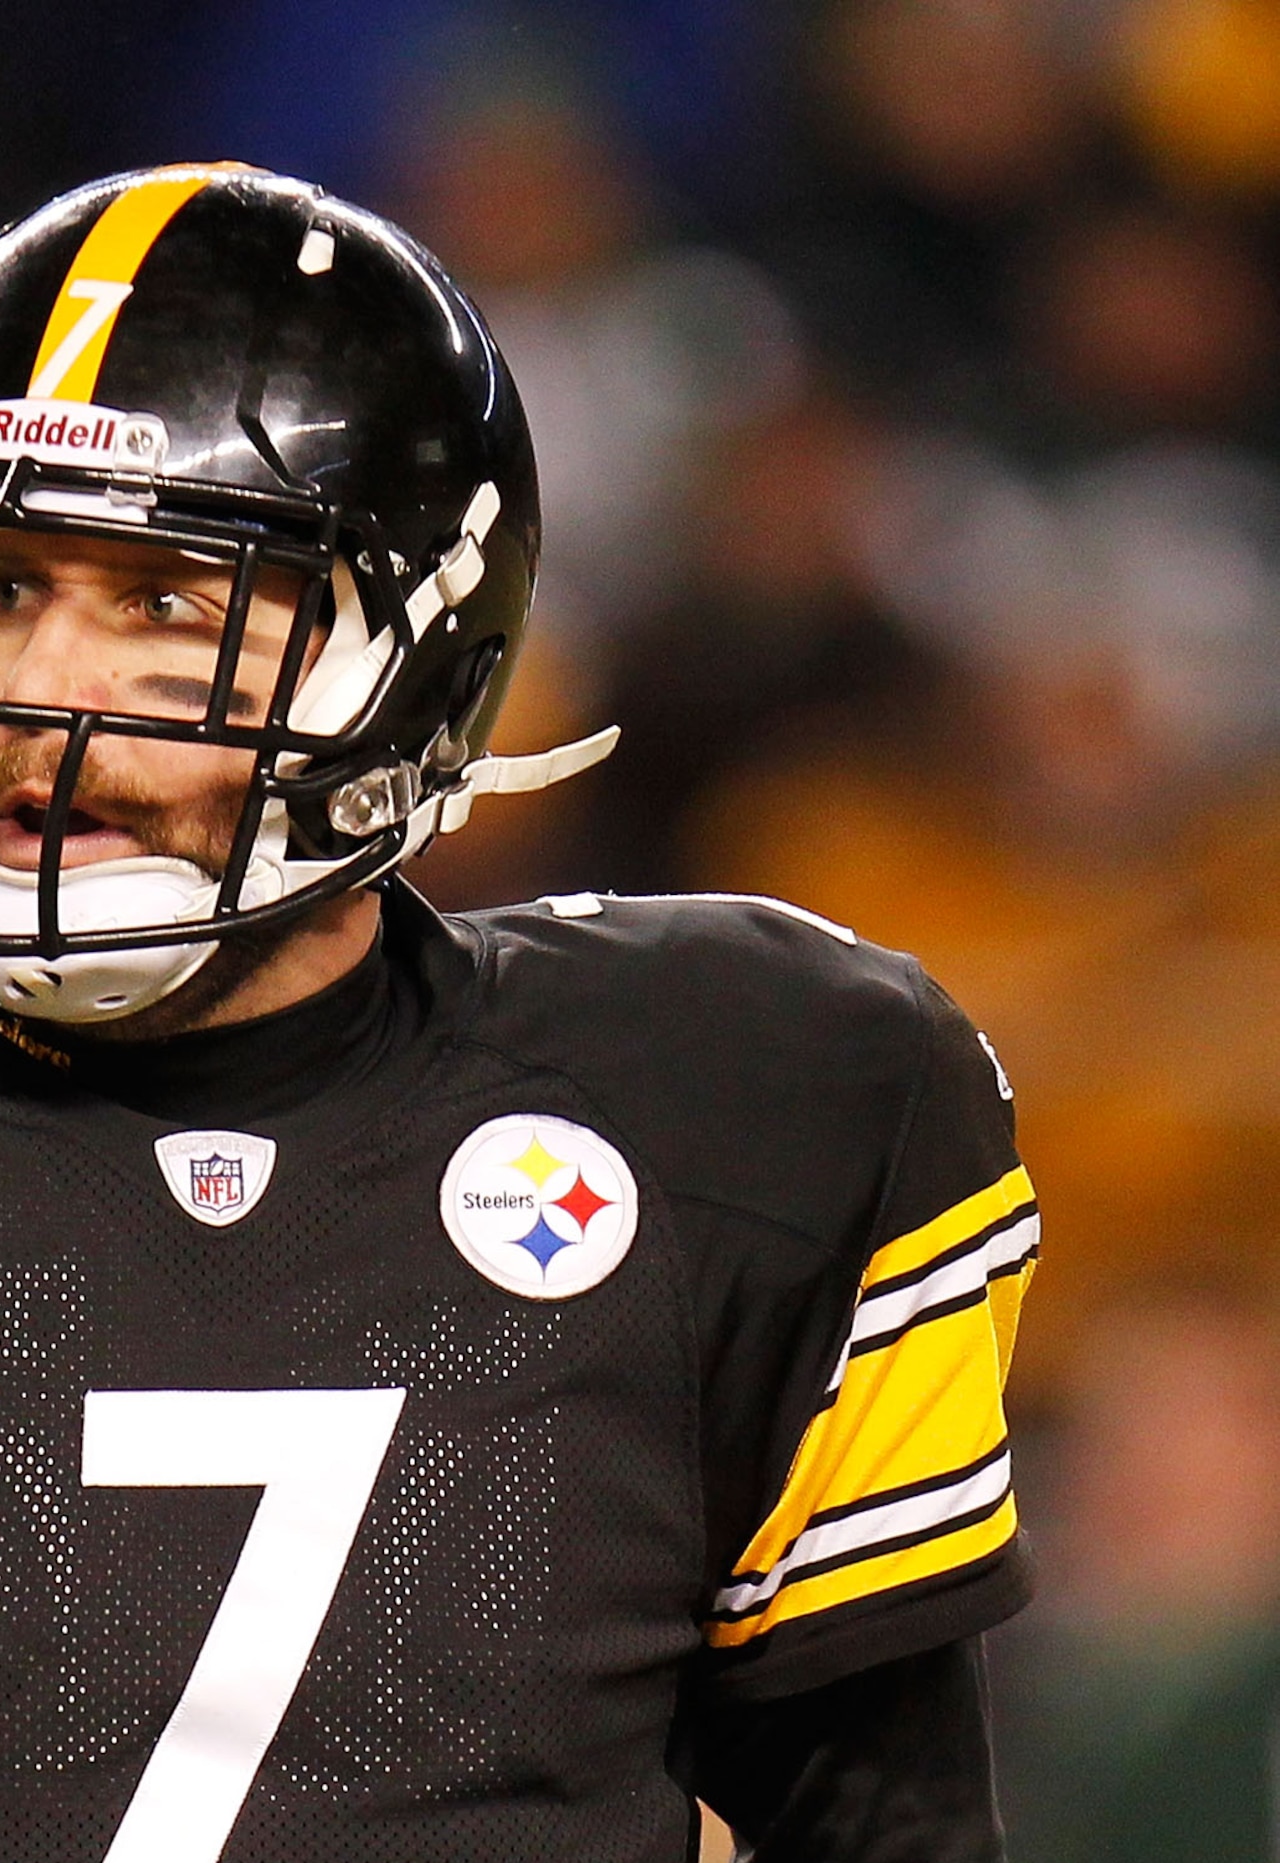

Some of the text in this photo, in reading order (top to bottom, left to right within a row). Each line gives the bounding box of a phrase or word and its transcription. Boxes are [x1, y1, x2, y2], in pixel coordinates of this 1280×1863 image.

[26, 278, 134, 400] 7
[195, 1176, 239, 1205] NFL
[463, 1191, 535, 1211] Steelers
